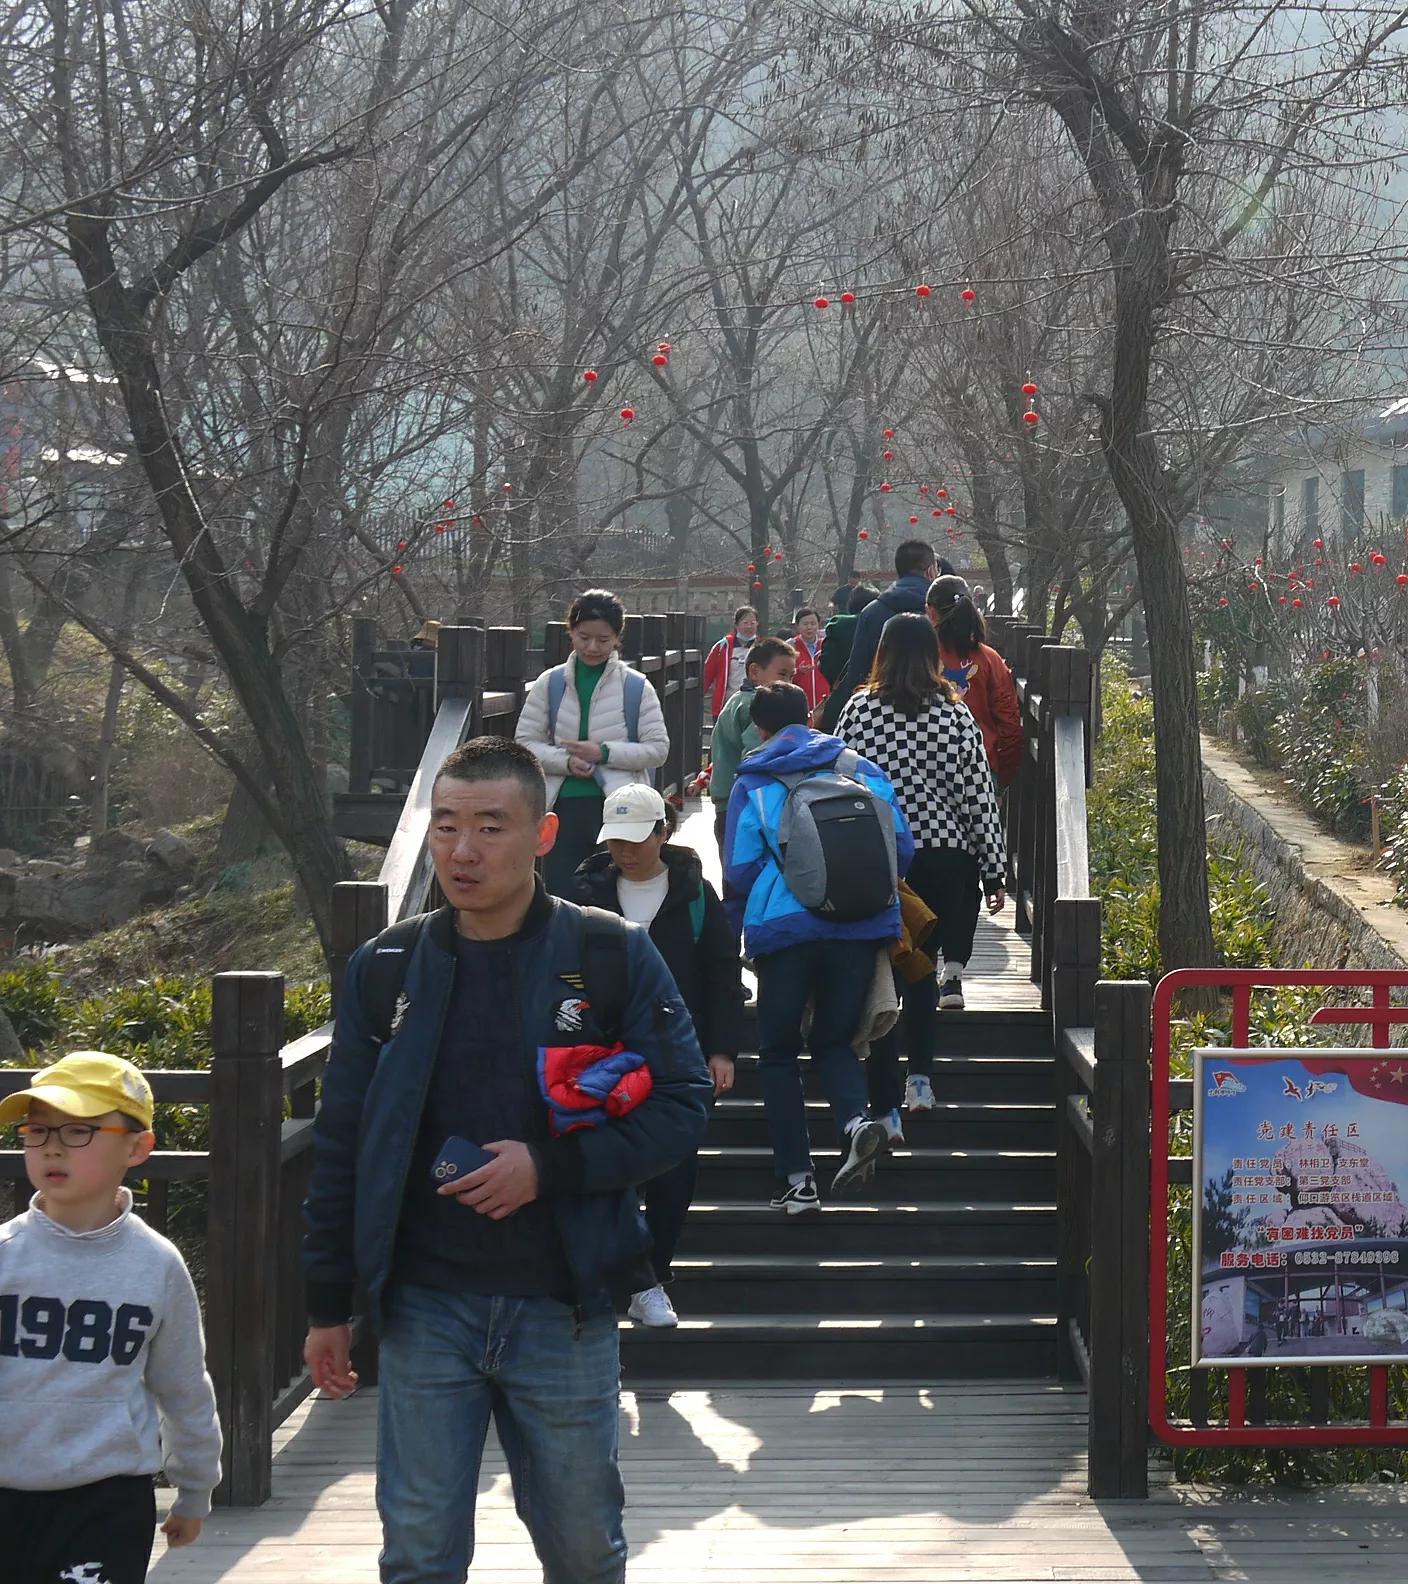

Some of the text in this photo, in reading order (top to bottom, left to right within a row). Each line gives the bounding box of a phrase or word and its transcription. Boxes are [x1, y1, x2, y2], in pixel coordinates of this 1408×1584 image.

[1257, 1120, 1360, 1140] 党建责任区
[0, 1294, 153, 1366] 1986
